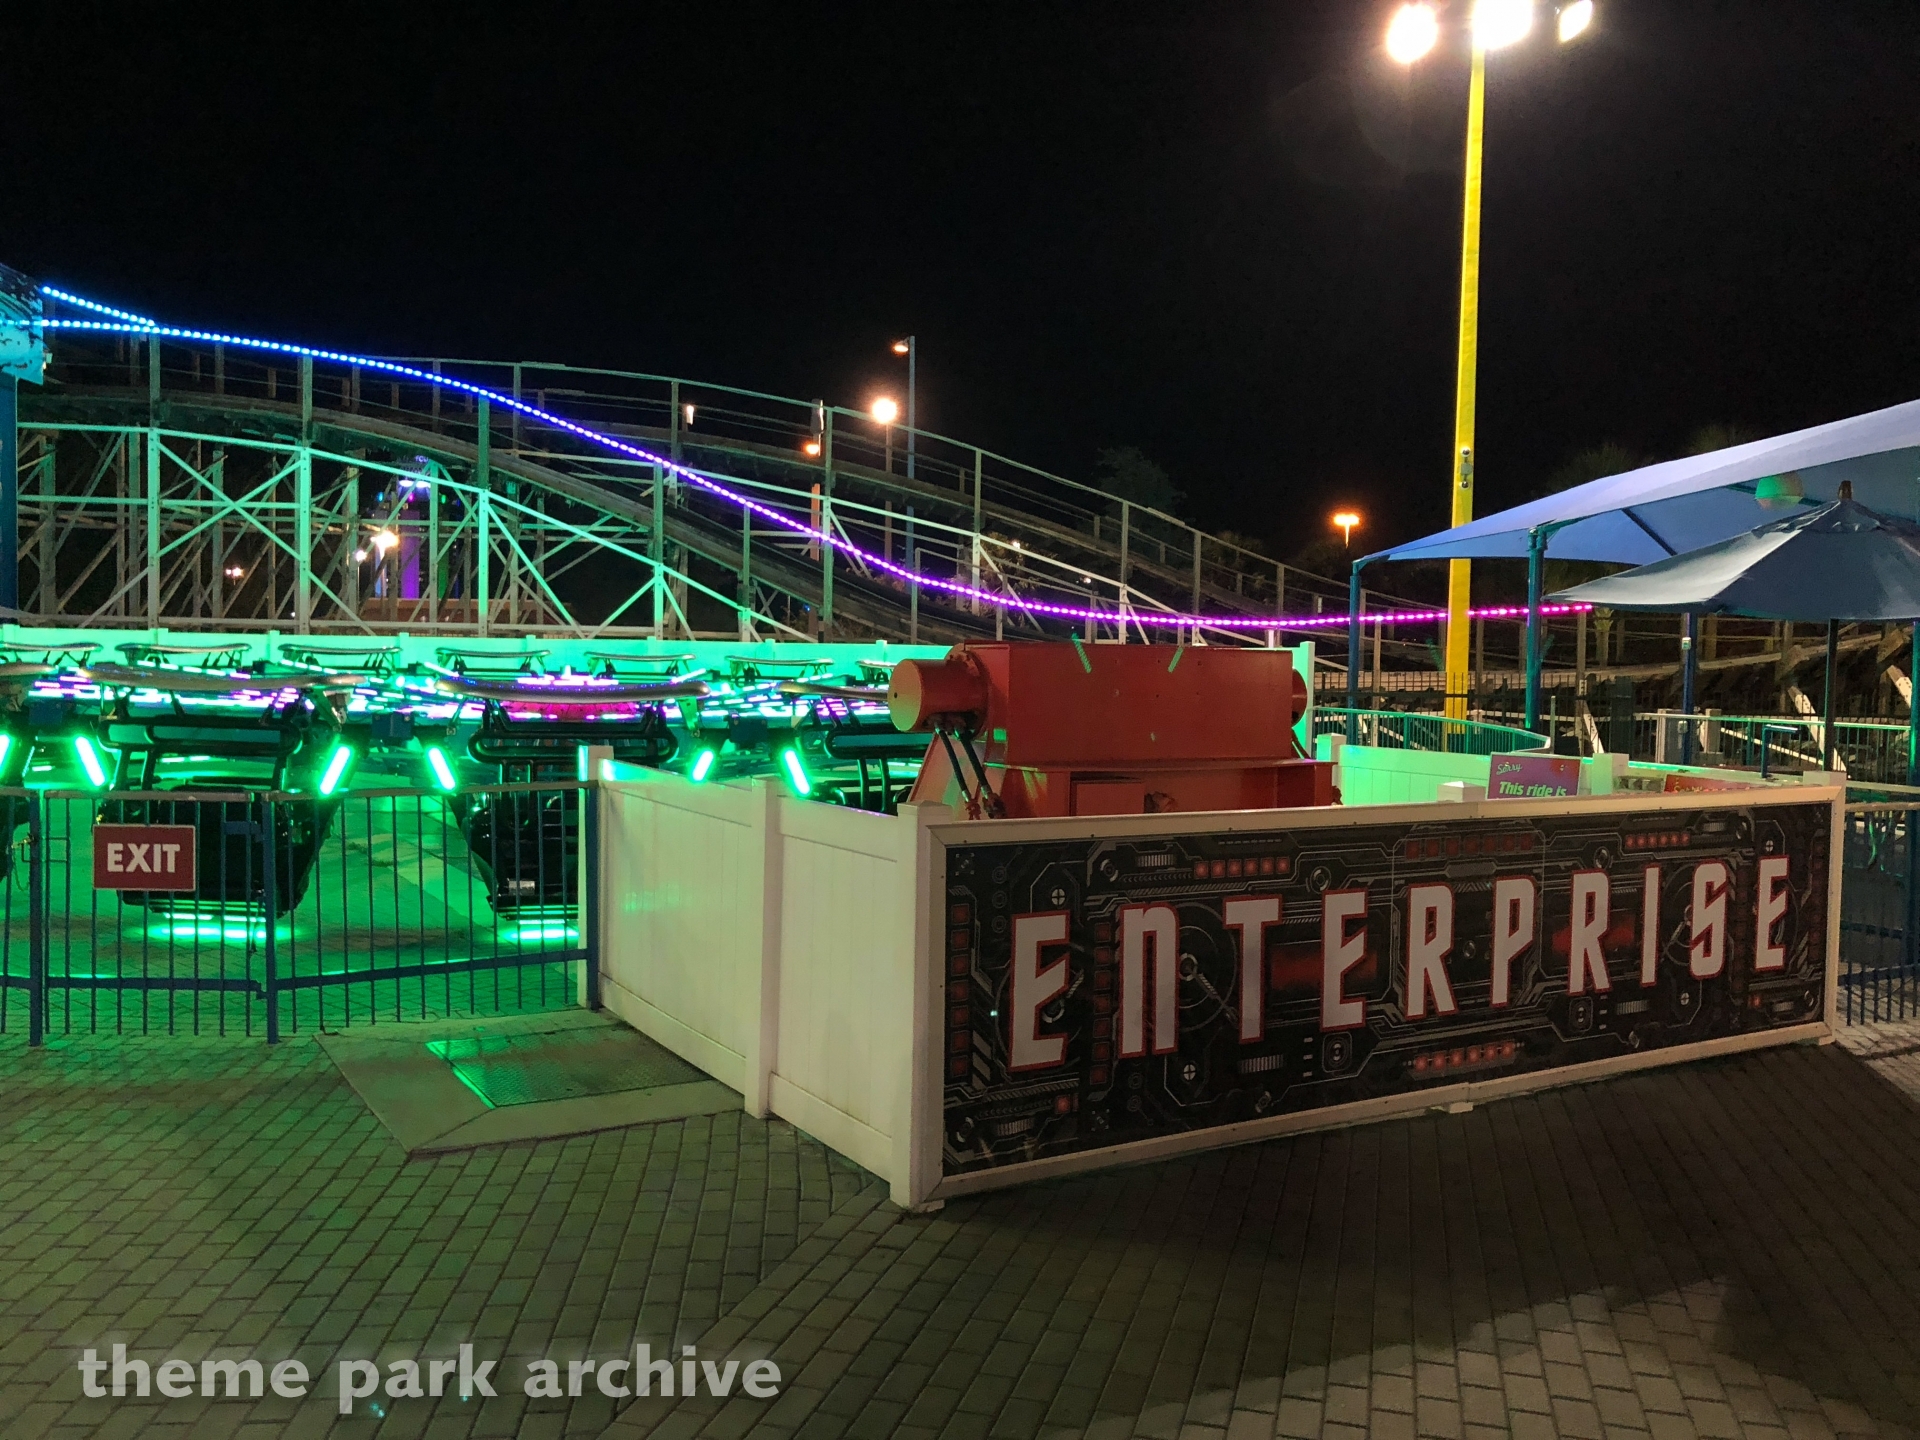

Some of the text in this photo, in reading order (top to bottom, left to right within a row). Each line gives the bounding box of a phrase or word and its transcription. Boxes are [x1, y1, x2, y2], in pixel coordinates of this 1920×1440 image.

[1500, 781, 1567, 797] This ride is
[107, 843, 180, 873] EXIT
[1009, 856, 1790, 1072] ENTERPRISE
